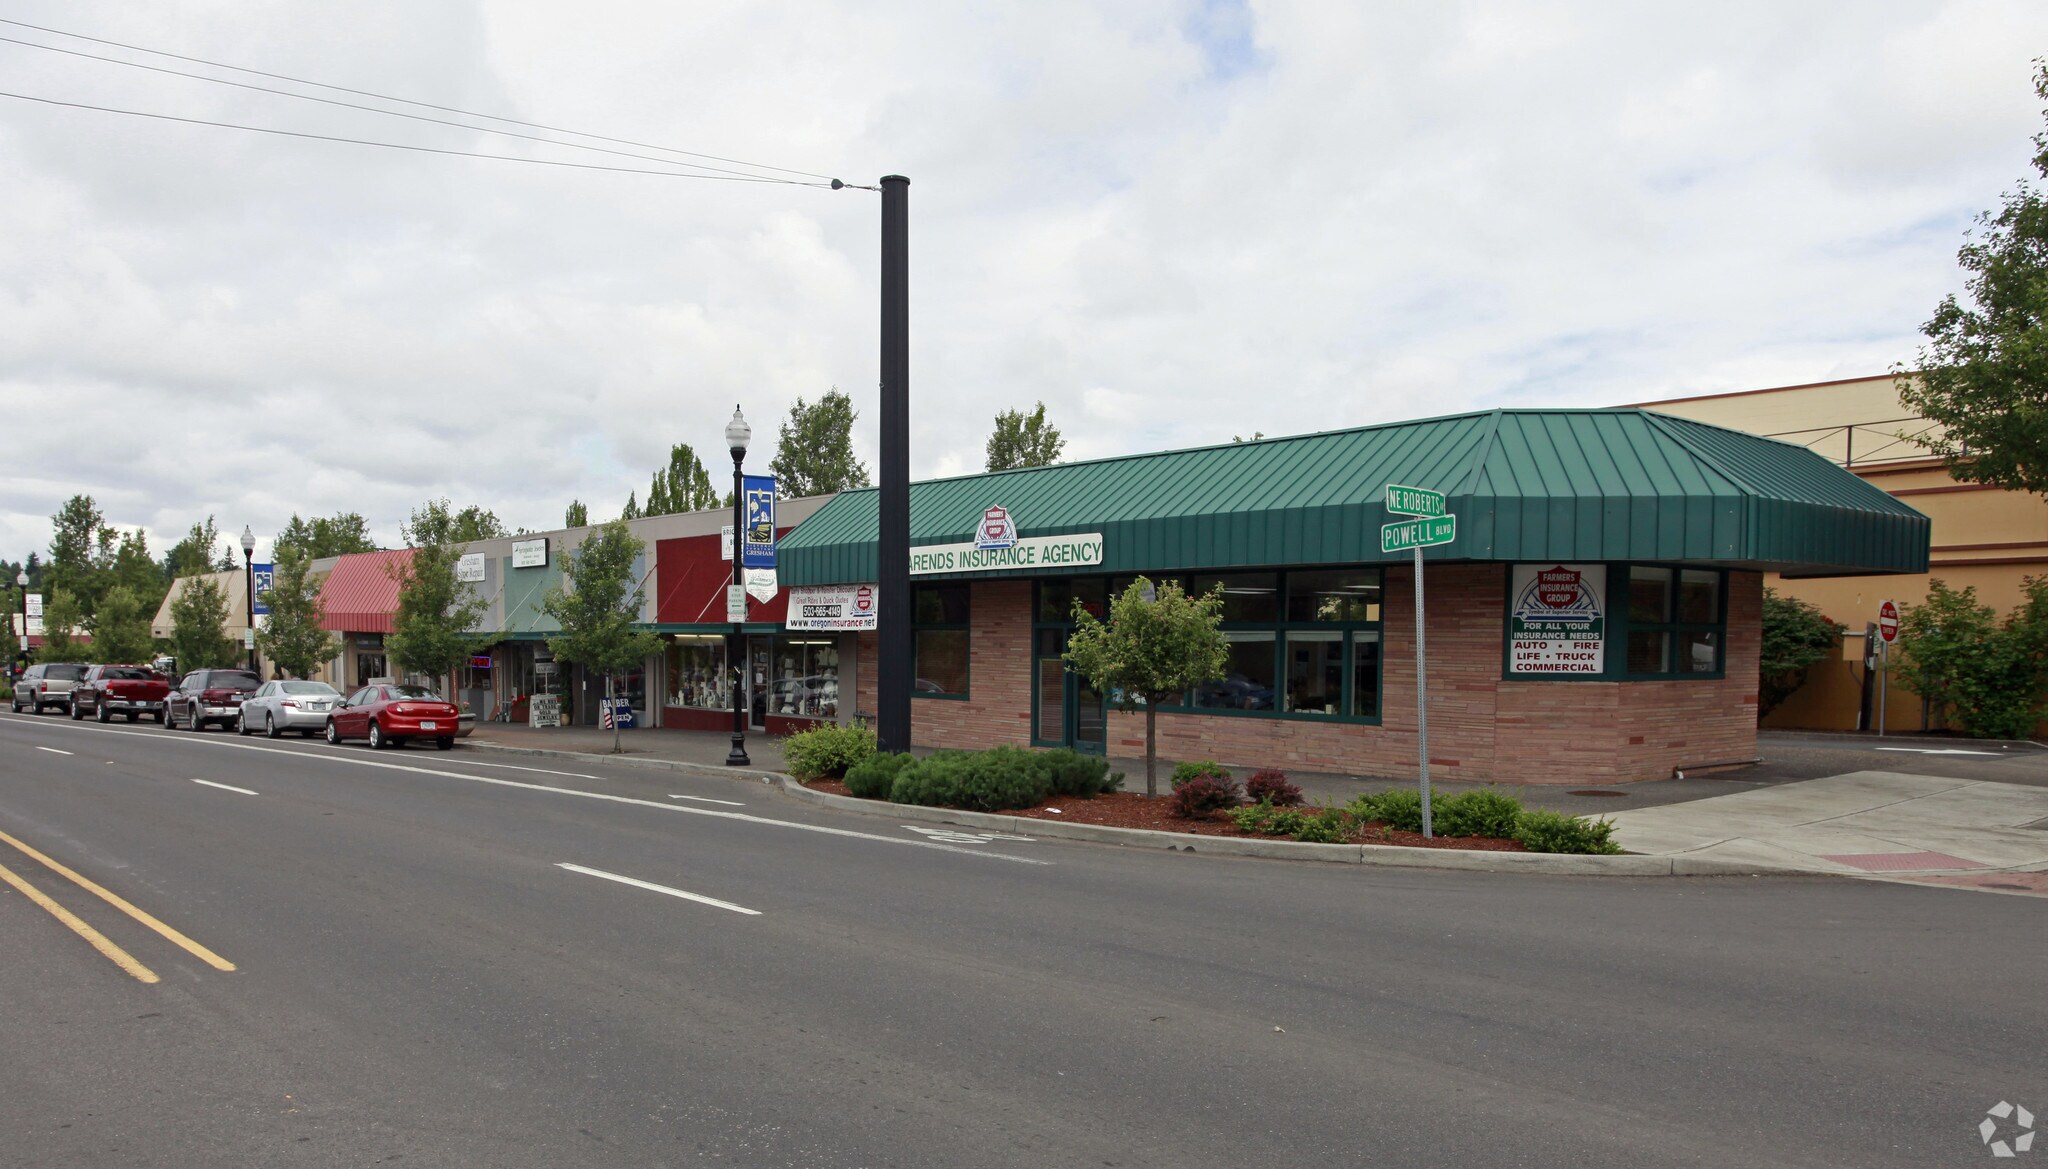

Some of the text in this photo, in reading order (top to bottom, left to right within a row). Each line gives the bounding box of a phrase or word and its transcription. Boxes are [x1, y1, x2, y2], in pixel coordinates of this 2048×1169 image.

[1389, 489, 1440, 514] NE ROBERTS
[1385, 523, 1452, 547] POWELL BLVD
[959, 546, 1036, 568] INSURANCE
[1041, 542, 1102, 564] AGENCY
[1543, 573, 1575, 581] FARMERS
[1540, 583, 1578, 592] INSURANCE
[796, 597, 807, 605] Great
[1546, 594, 1571, 602] GROUP
[803, 605, 841, 617] 503-665-4149
[1882, 608, 1888, 616] DO
[790, 618, 875, 628] www.oregoninsurance.net
[1523, 622, 1590, 631] FOR ALL YOUR
[1883, 626, 1894, 635] ENTER
[1513, 632, 1600, 640] INSURANCE NEEDS
[1514, 641, 1600, 650] AUTO FIRE
[1517, 652, 1595, 661] LIFE TRUCK
[1516, 663, 1596, 672] COMMERCIAL
[602, 698, 630, 708] BABER
